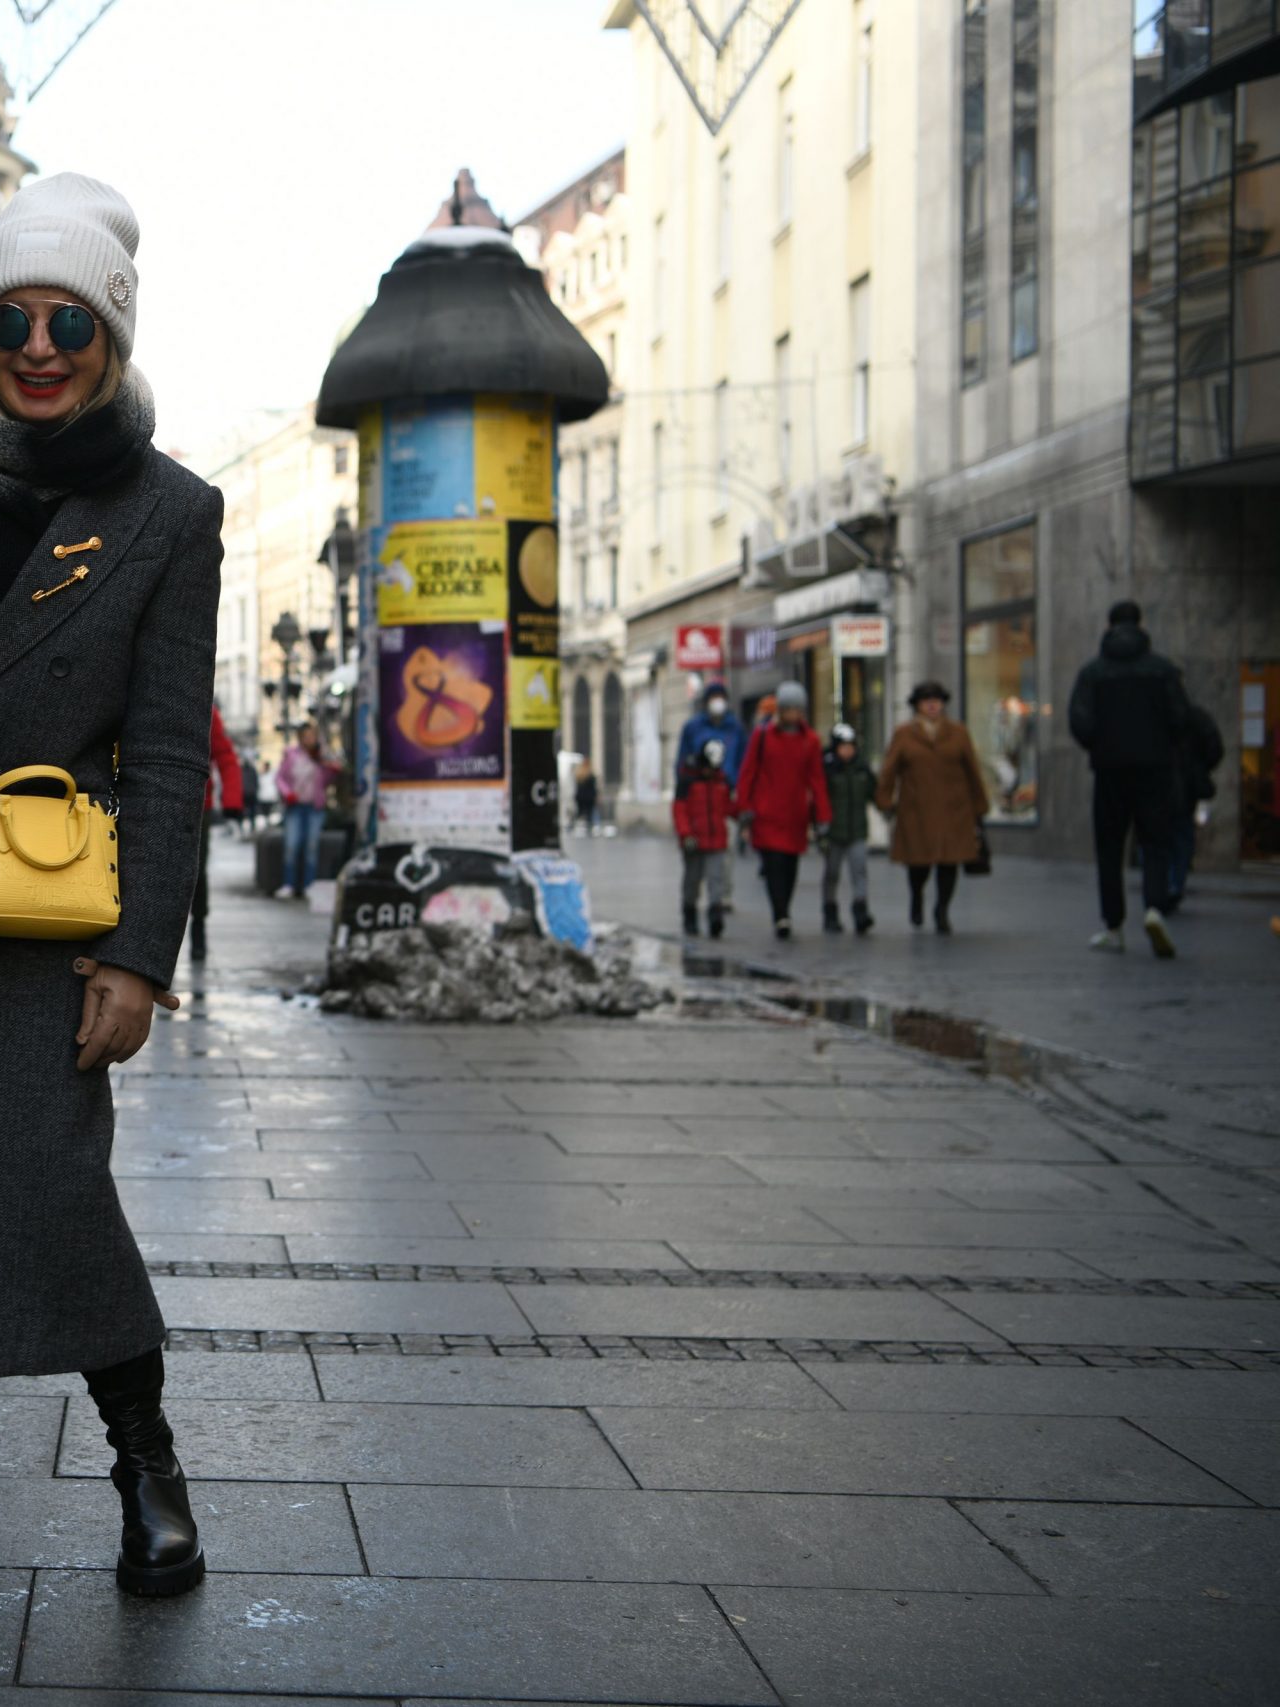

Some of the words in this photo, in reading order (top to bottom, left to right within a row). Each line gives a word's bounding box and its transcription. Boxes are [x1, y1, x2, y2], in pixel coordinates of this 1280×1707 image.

[416, 560, 503, 579] СВРАБА
[417, 579, 484, 597] КОЖЕ
[356, 903, 417, 928] CAR
